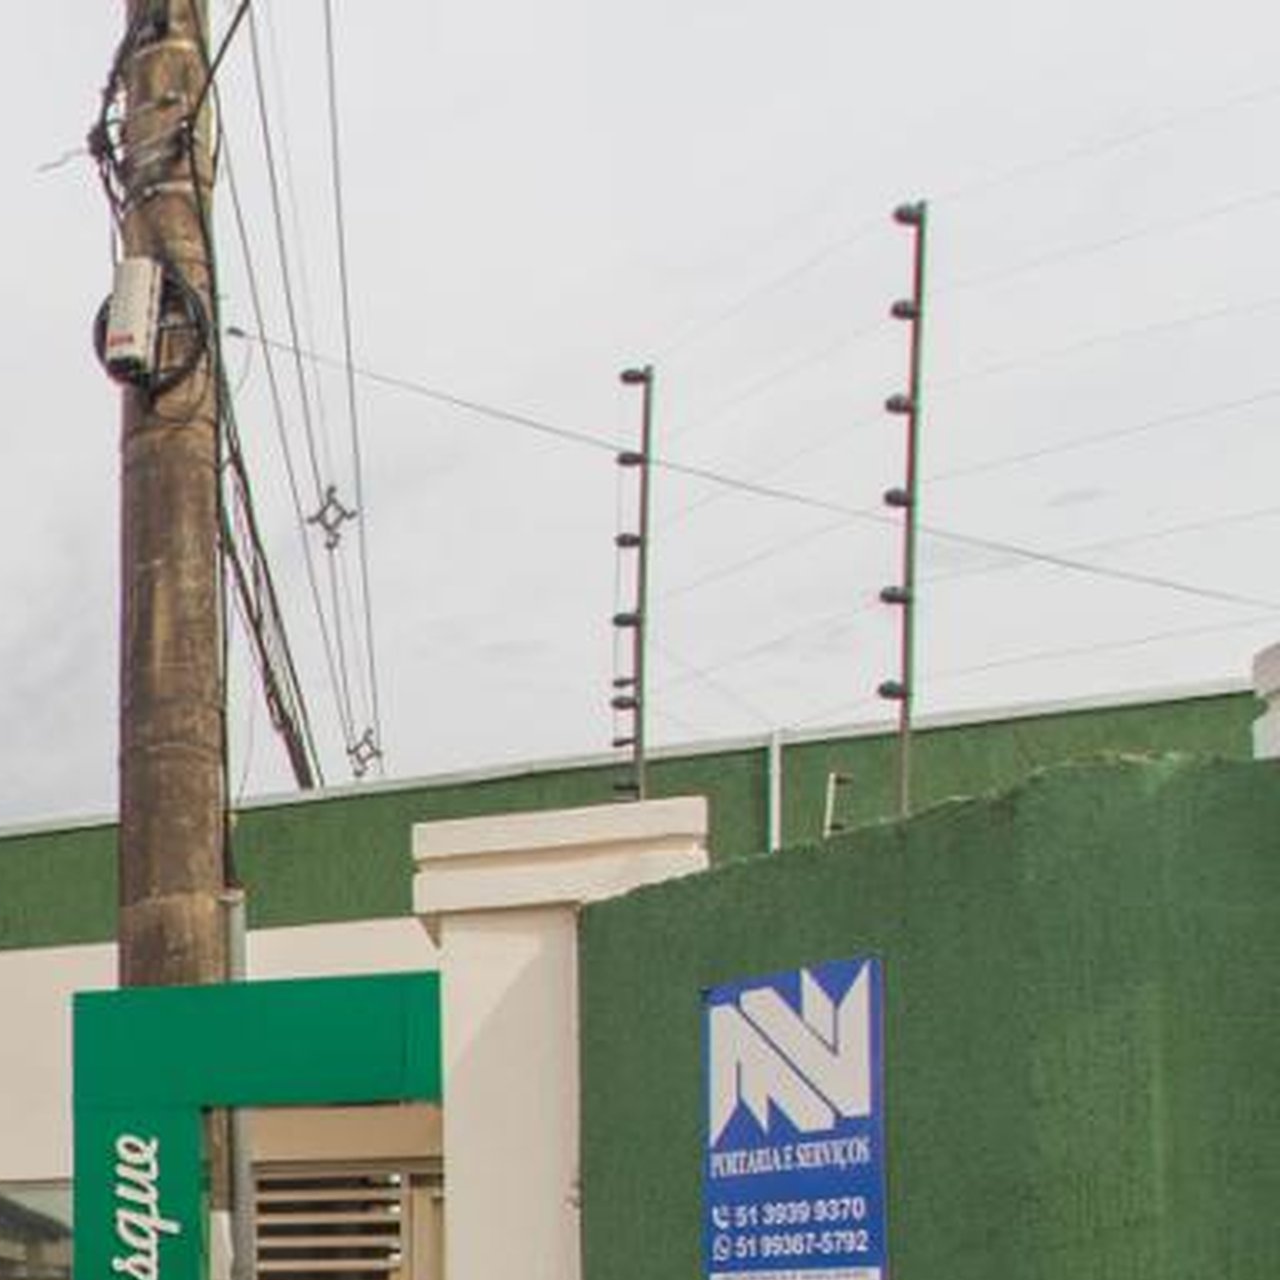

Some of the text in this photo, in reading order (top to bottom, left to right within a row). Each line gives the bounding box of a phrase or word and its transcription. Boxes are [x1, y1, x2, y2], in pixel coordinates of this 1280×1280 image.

[735, 1203, 758, 1227] 51
[761, 1201, 811, 1225] 3939
[735, 1235, 757, 1259] 51
